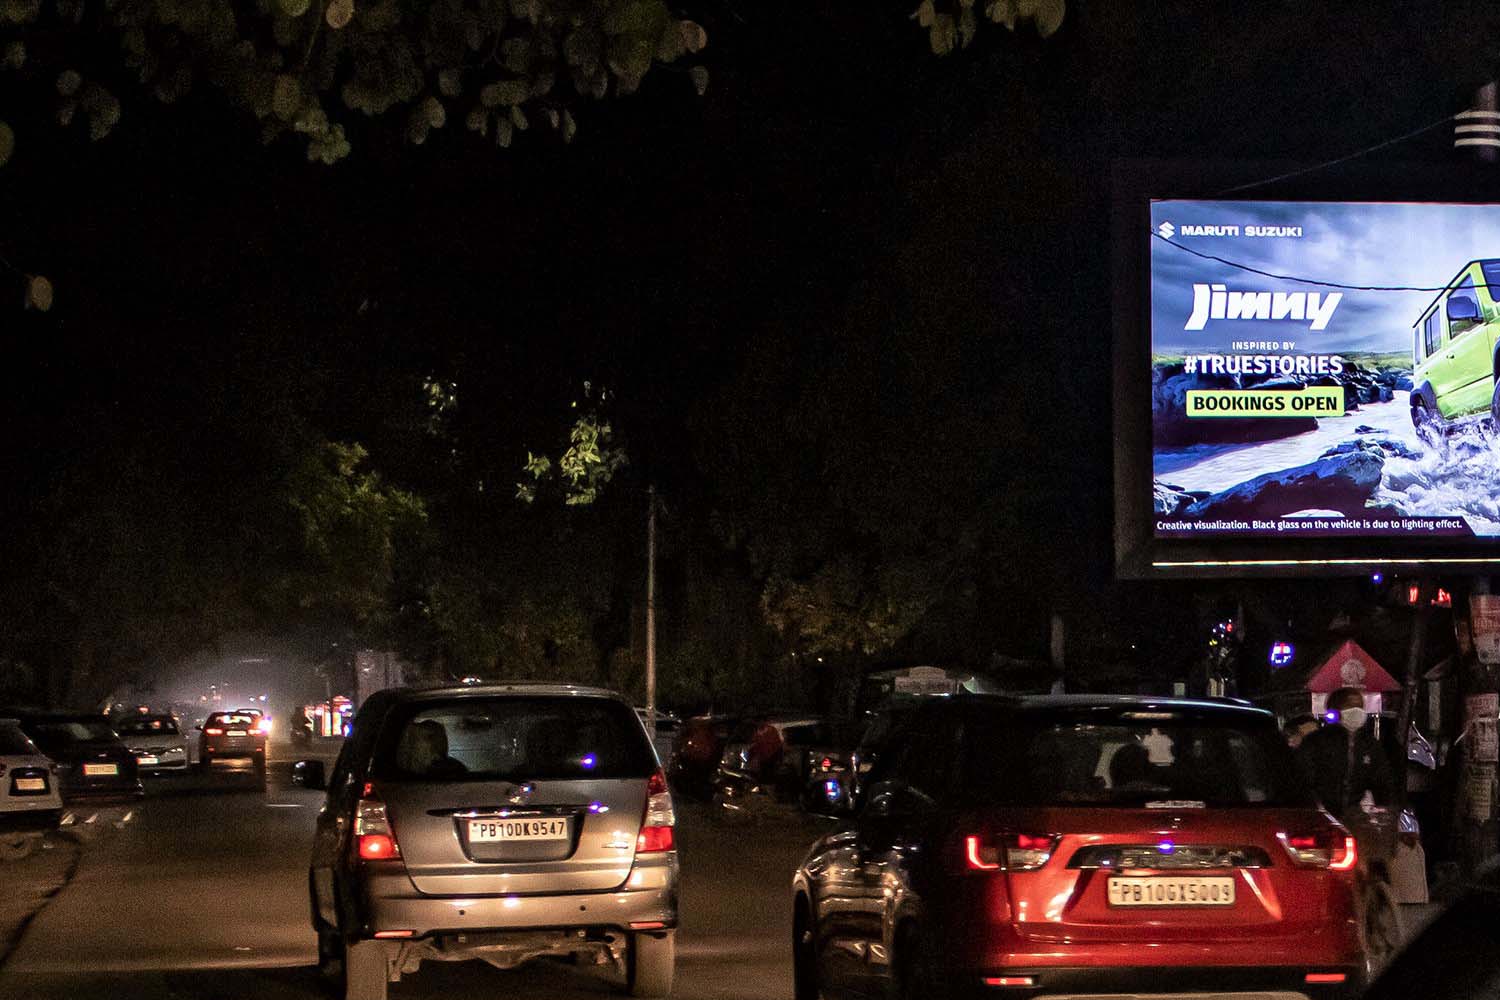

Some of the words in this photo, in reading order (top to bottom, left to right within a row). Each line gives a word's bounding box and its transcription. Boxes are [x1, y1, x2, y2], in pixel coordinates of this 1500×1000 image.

[1180, 225, 1239, 237] MARUTI
[1244, 225, 1302, 237] SUZUKI
[1183, 283, 1344, 331] Jimny
[1232, 341, 1280, 350] INSPIRED
[1283, 341, 1296, 350] BY
[1184, 355, 1343, 374] #TRUESTORIES
[1193, 396, 1285, 411] BOOKINGS
[1291, 396, 1337, 411] OPEN
[1156, 521, 1192, 530] Creative
[1193, 520, 1250, 530] visualization.
[1252, 520, 1276, 529] Black
[1277, 521, 1300, 531] glass
[1301, 521, 1313, 529] on
[1314, 520, 1329, 529] the
[1330, 519, 1361, 529] vehicle
[1363, 519, 1371, 528] is
[1372, 520, 1389, 529] due
[1390, 520, 1400, 529] to
[1401, 519, 1434, 530] lighting
[1435, 519, 1463, 529] effect.
[480, 821, 565, 838] PB10DK9547
